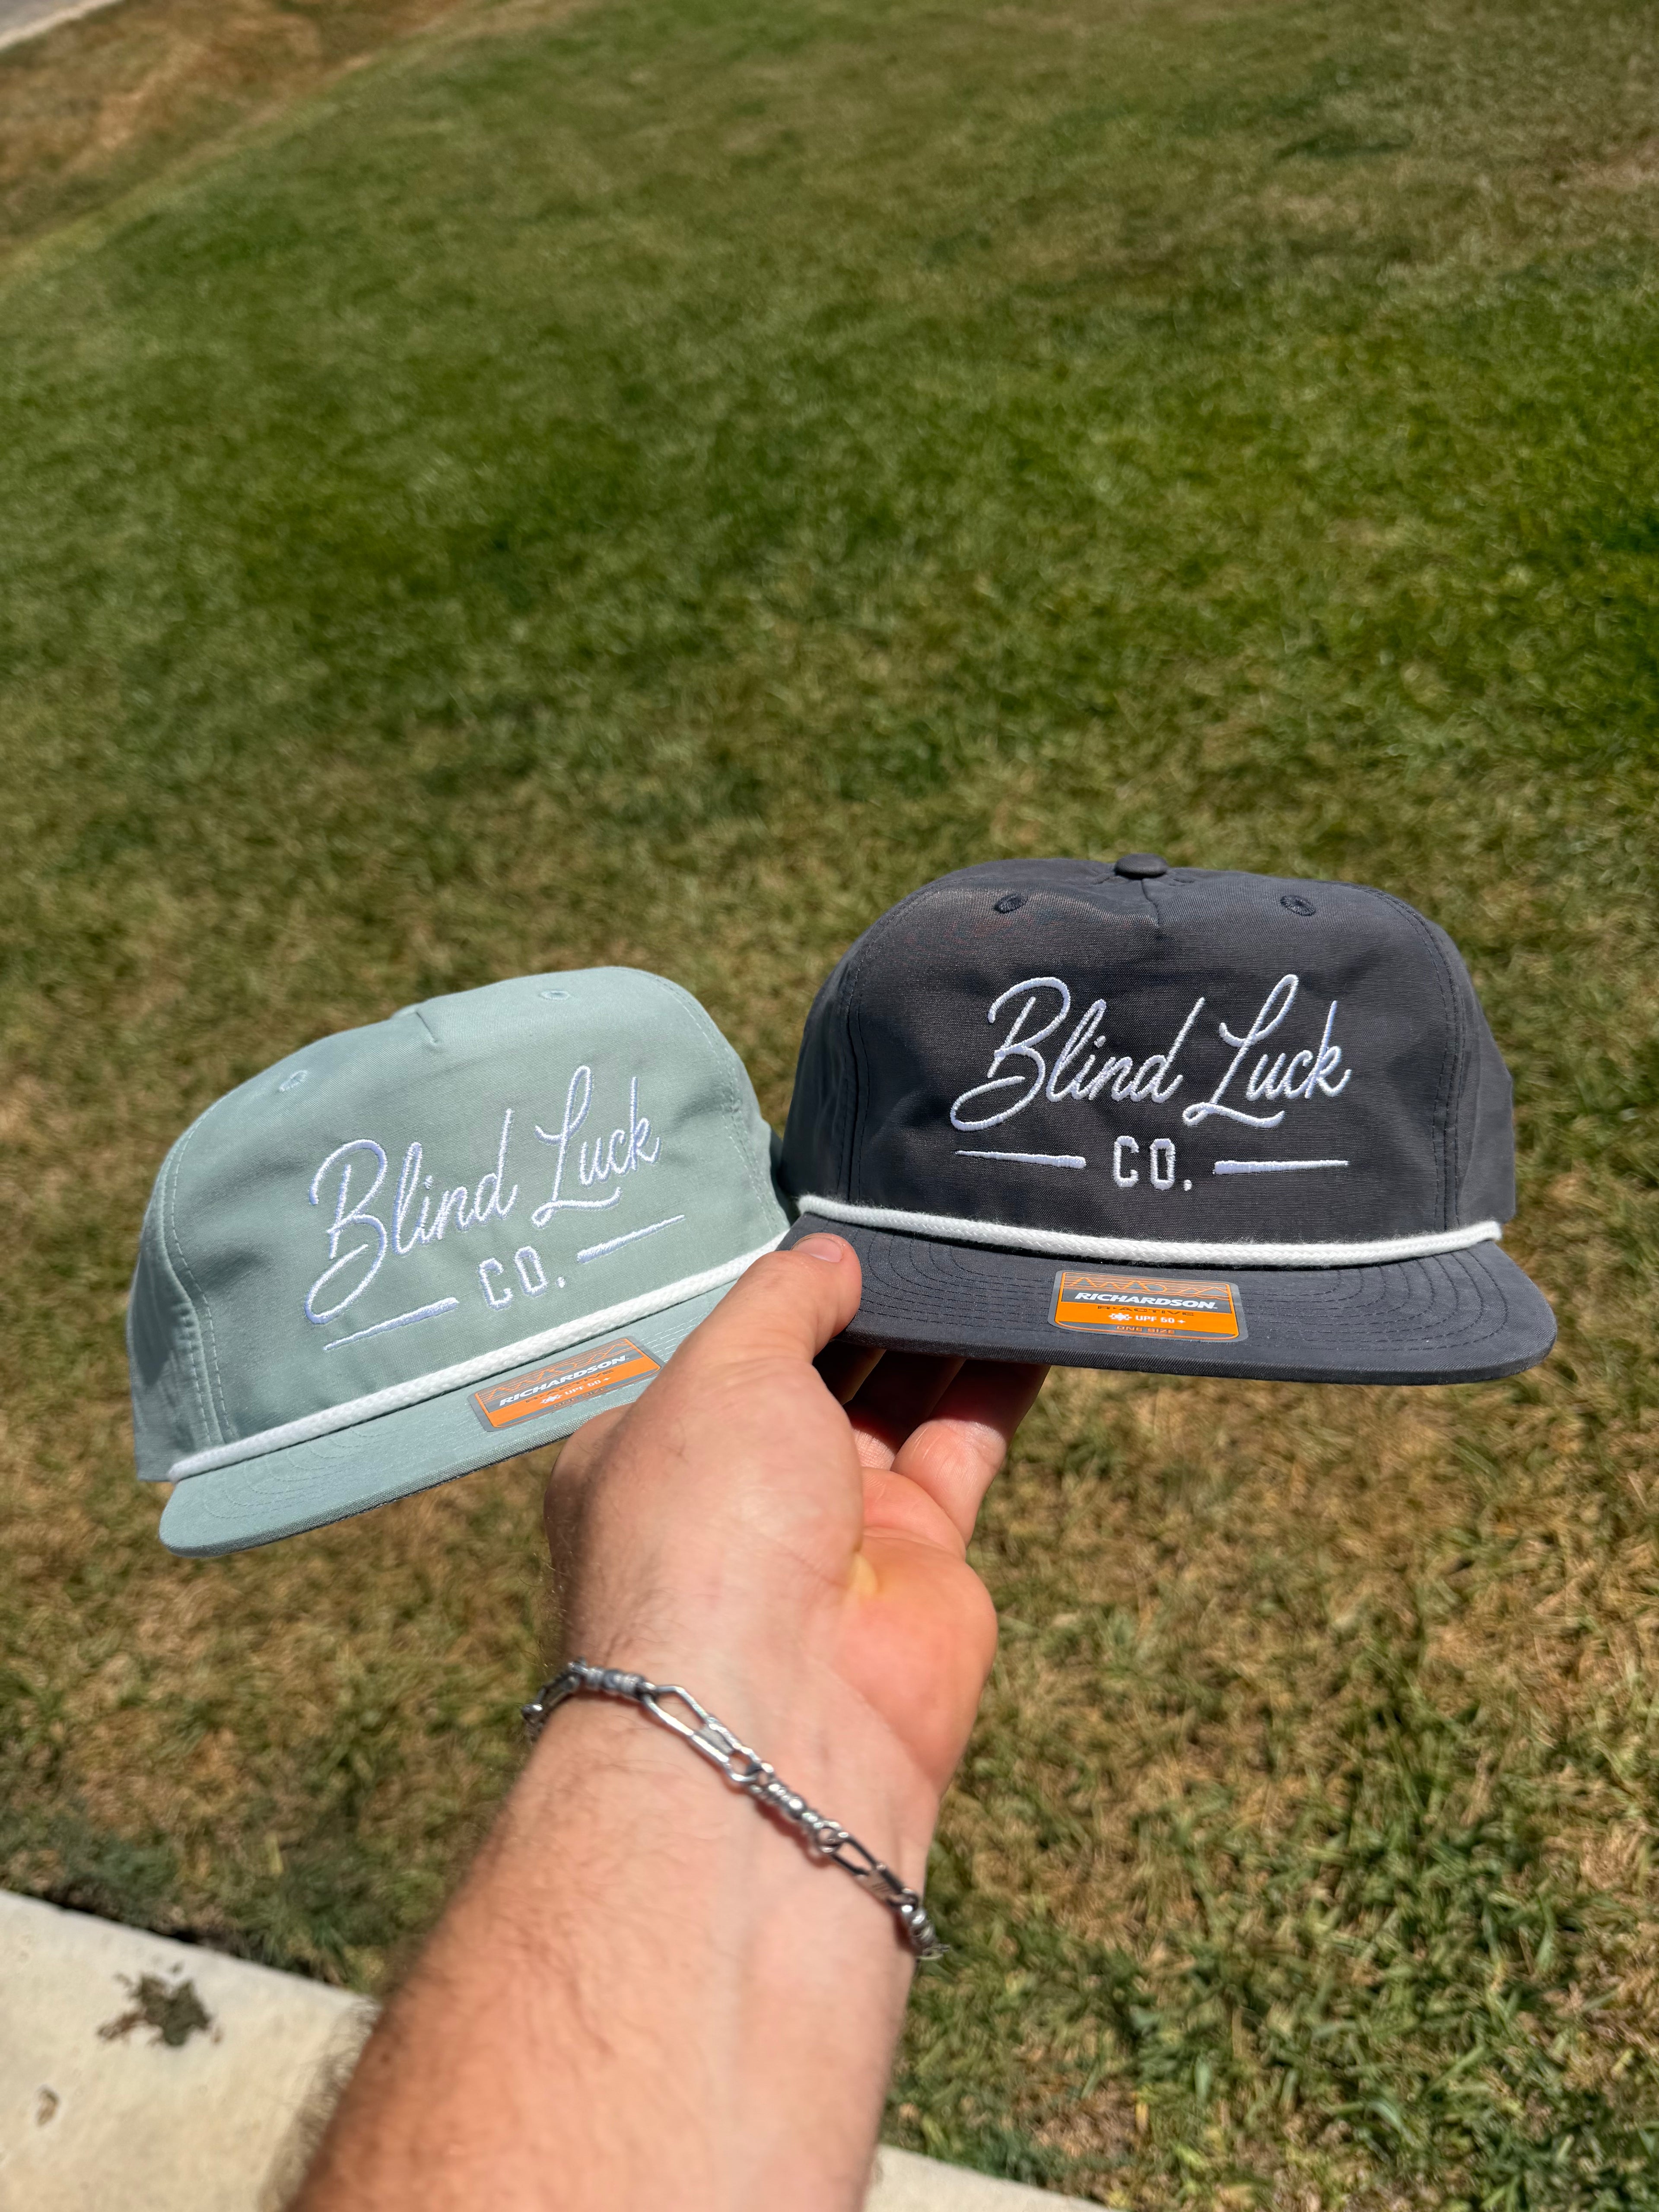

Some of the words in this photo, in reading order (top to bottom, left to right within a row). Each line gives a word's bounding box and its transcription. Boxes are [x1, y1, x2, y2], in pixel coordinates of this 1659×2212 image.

[950, 976, 1205, 1131] Blind
[1182, 974, 1352, 1127] Luck
[1113, 1135, 1192, 1191] CO.
[305, 1109, 518, 1324] Blind
[531, 1065, 661, 1228] Luck
[478, 1246, 566, 1309] CO.
[1074, 1292, 1216, 1309] RICHARDSON
[499, 1355, 627, 1406] RICHARDSON
[565, 1385, 585, 1395] UPF
